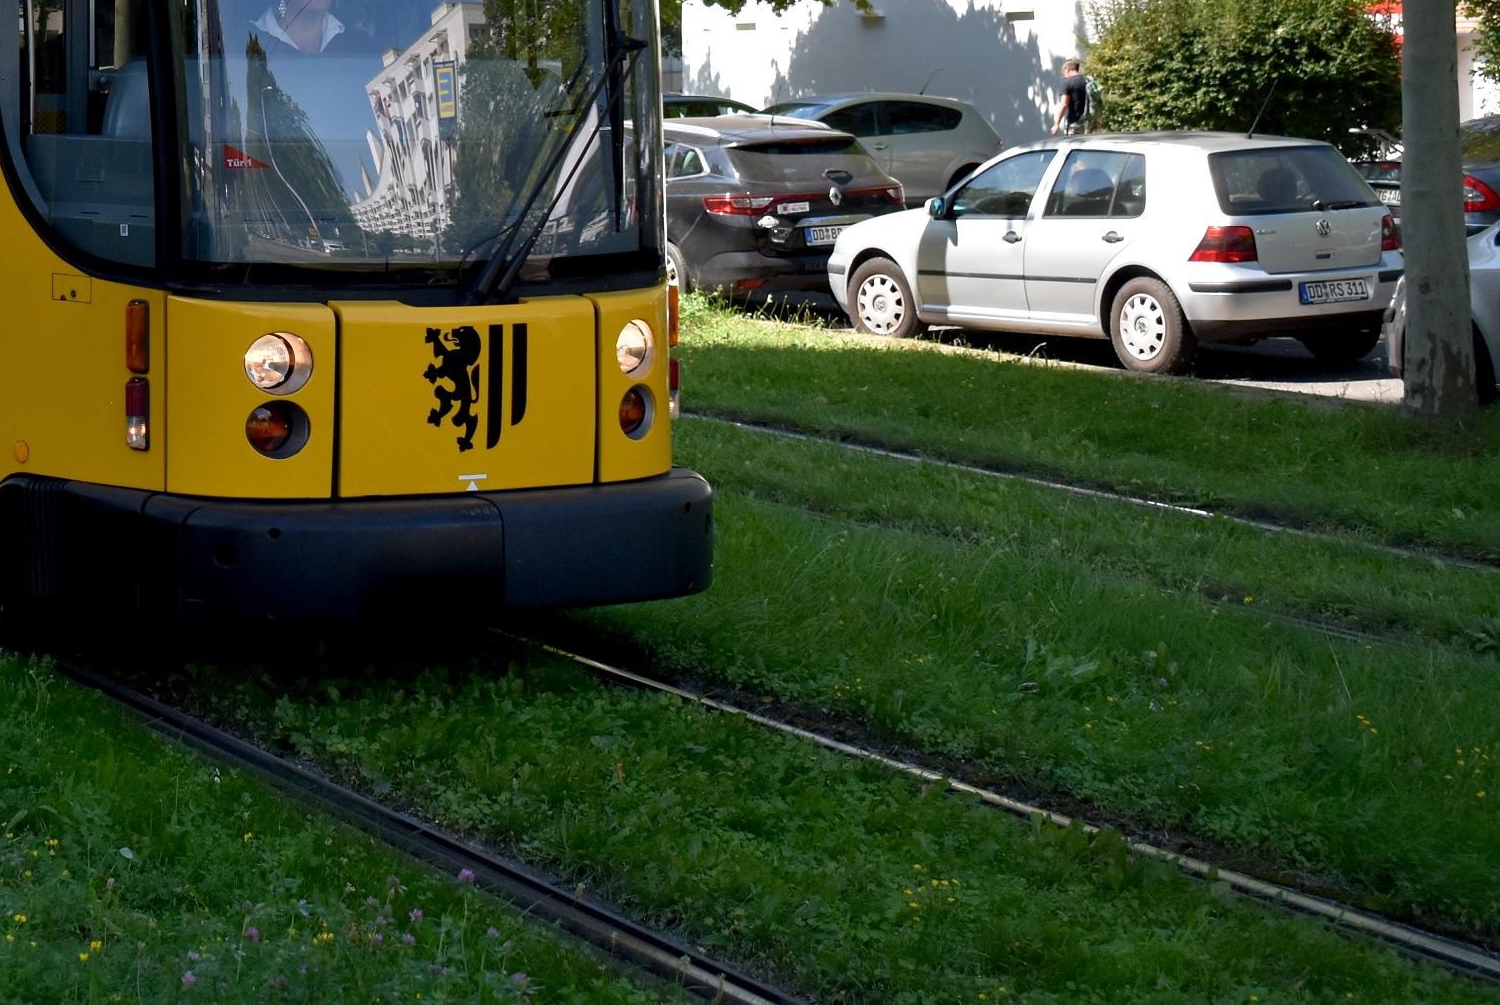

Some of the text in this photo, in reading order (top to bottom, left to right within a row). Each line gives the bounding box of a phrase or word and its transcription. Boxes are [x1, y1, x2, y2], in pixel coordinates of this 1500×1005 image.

[1307, 281, 1367, 299] DD RS 311
